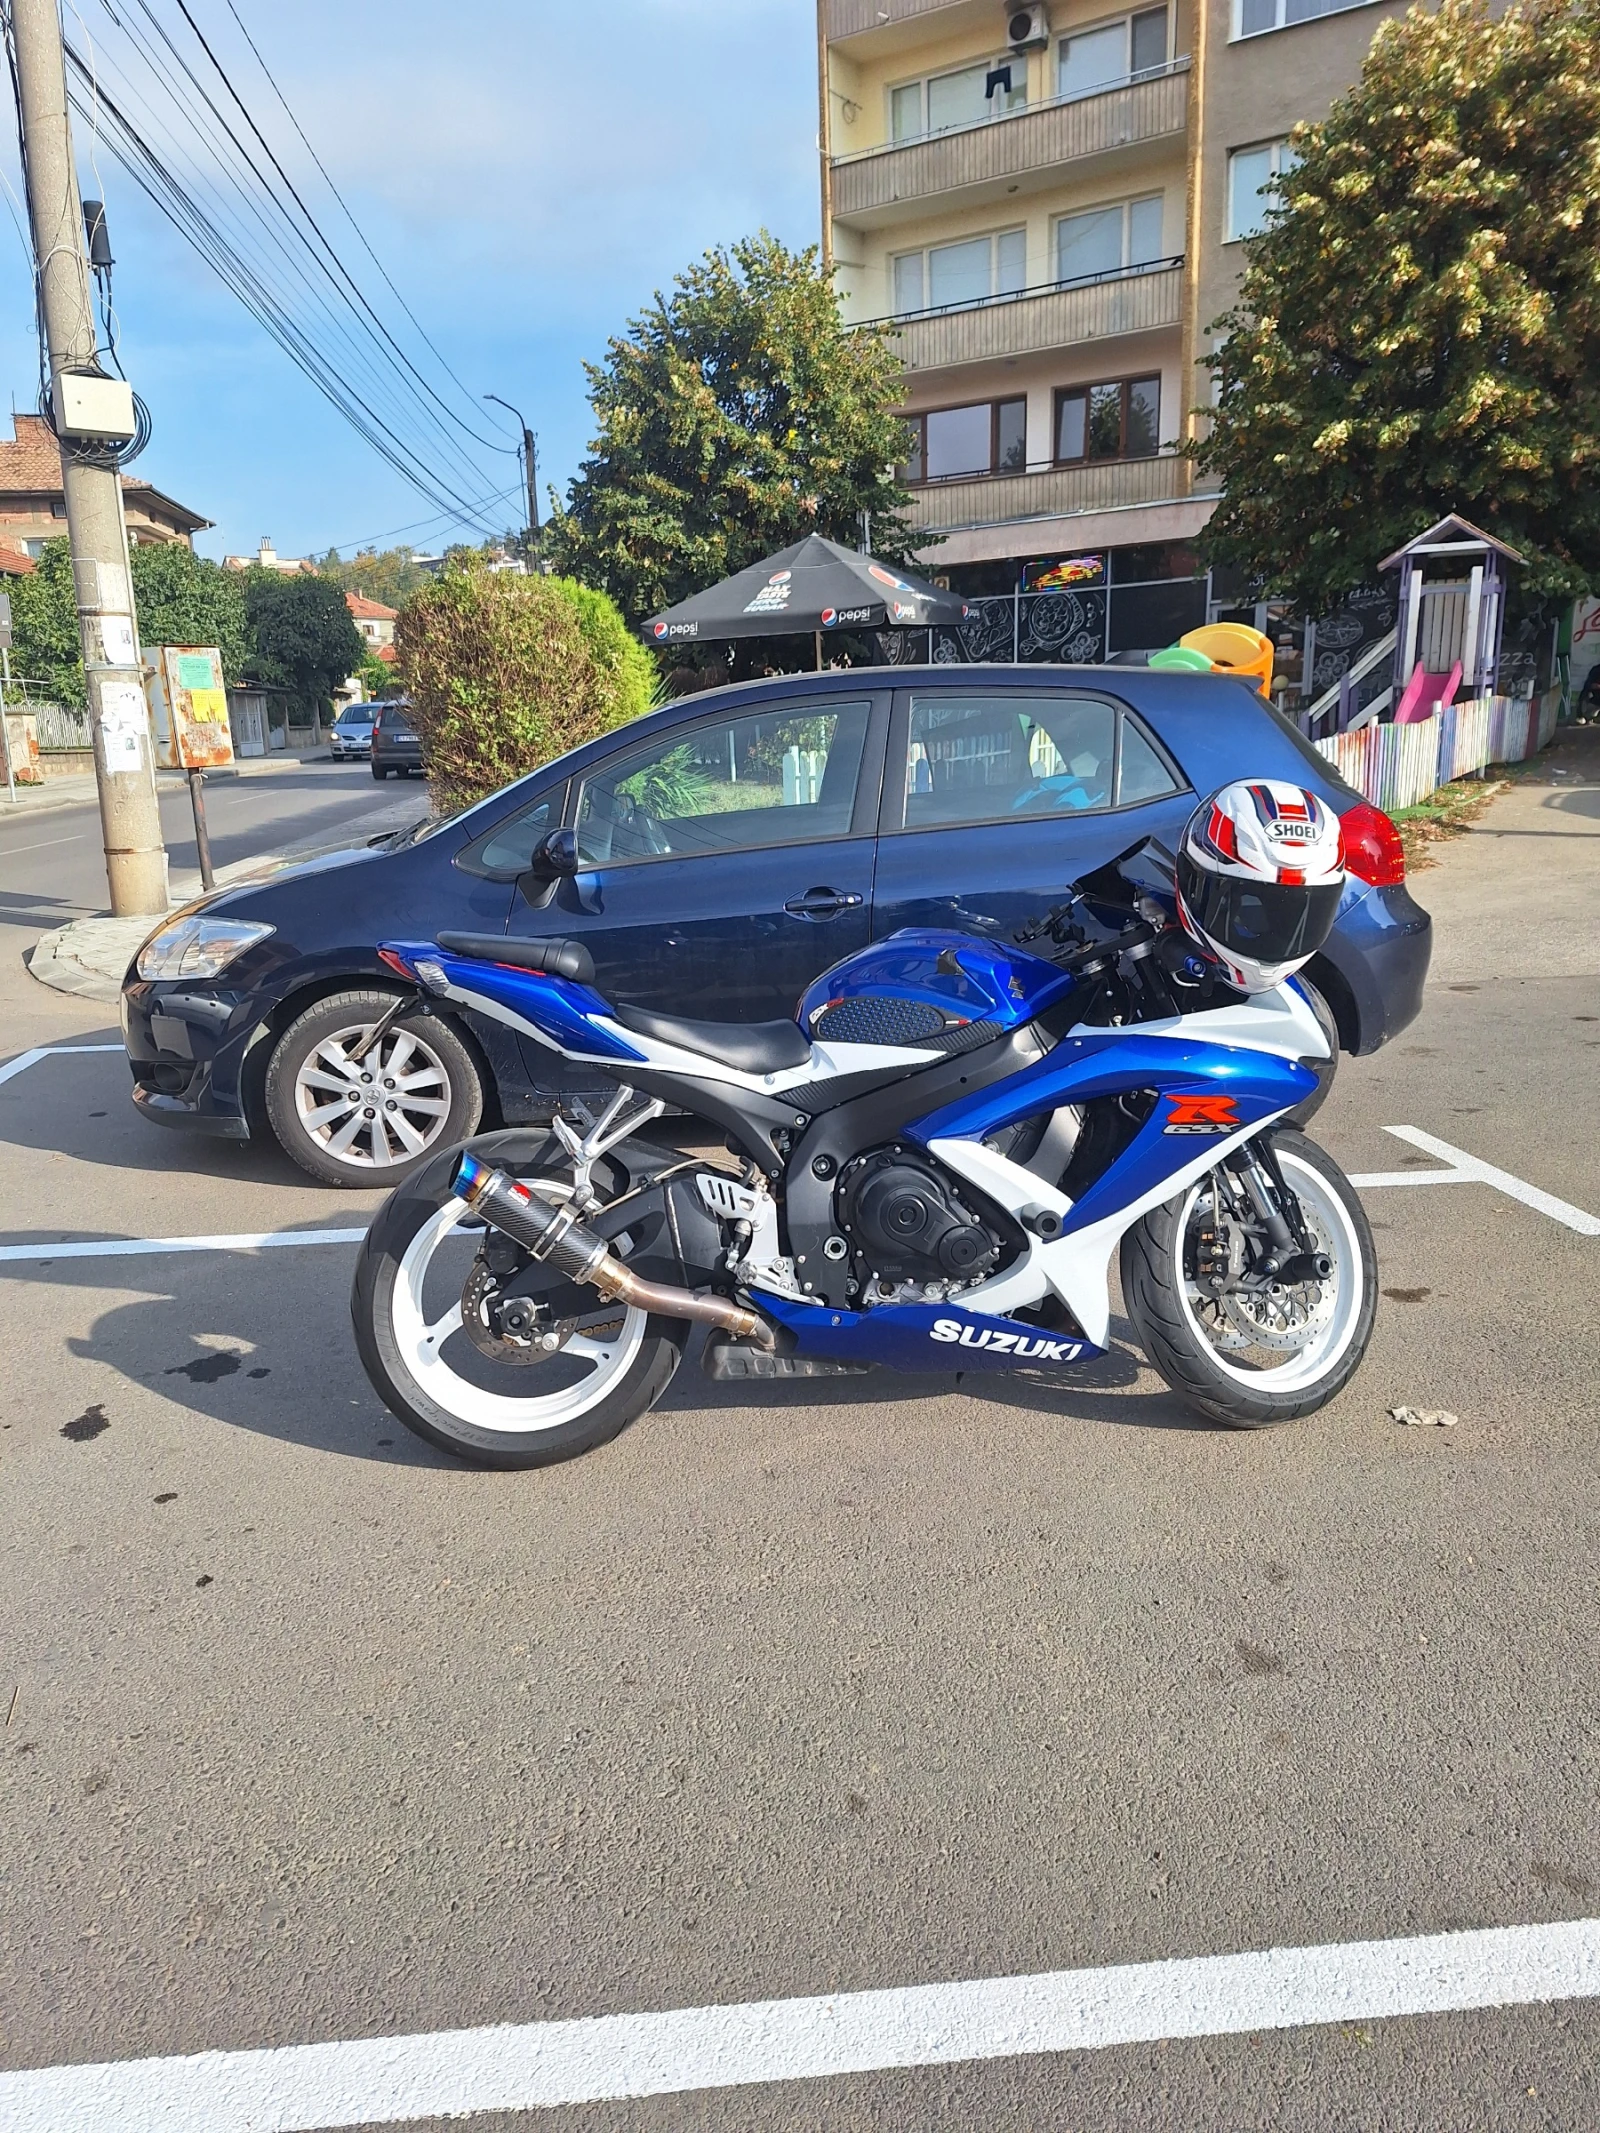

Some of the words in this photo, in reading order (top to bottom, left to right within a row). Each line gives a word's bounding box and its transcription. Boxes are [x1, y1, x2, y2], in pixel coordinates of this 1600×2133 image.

[756, 591, 791, 600] TASTE
[838, 607, 870, 623] pepsi
[901, 604, 916, 618] pepsi
[670, 622, 698, 636] pepsi
[1274, 824, 1316, 839] SHOEI
[1165, 1094, 1240, 1124] R
[1163, 1123, 1240, 1134] GSX
[929, 1319, 1083, 1361] SUZUKI
